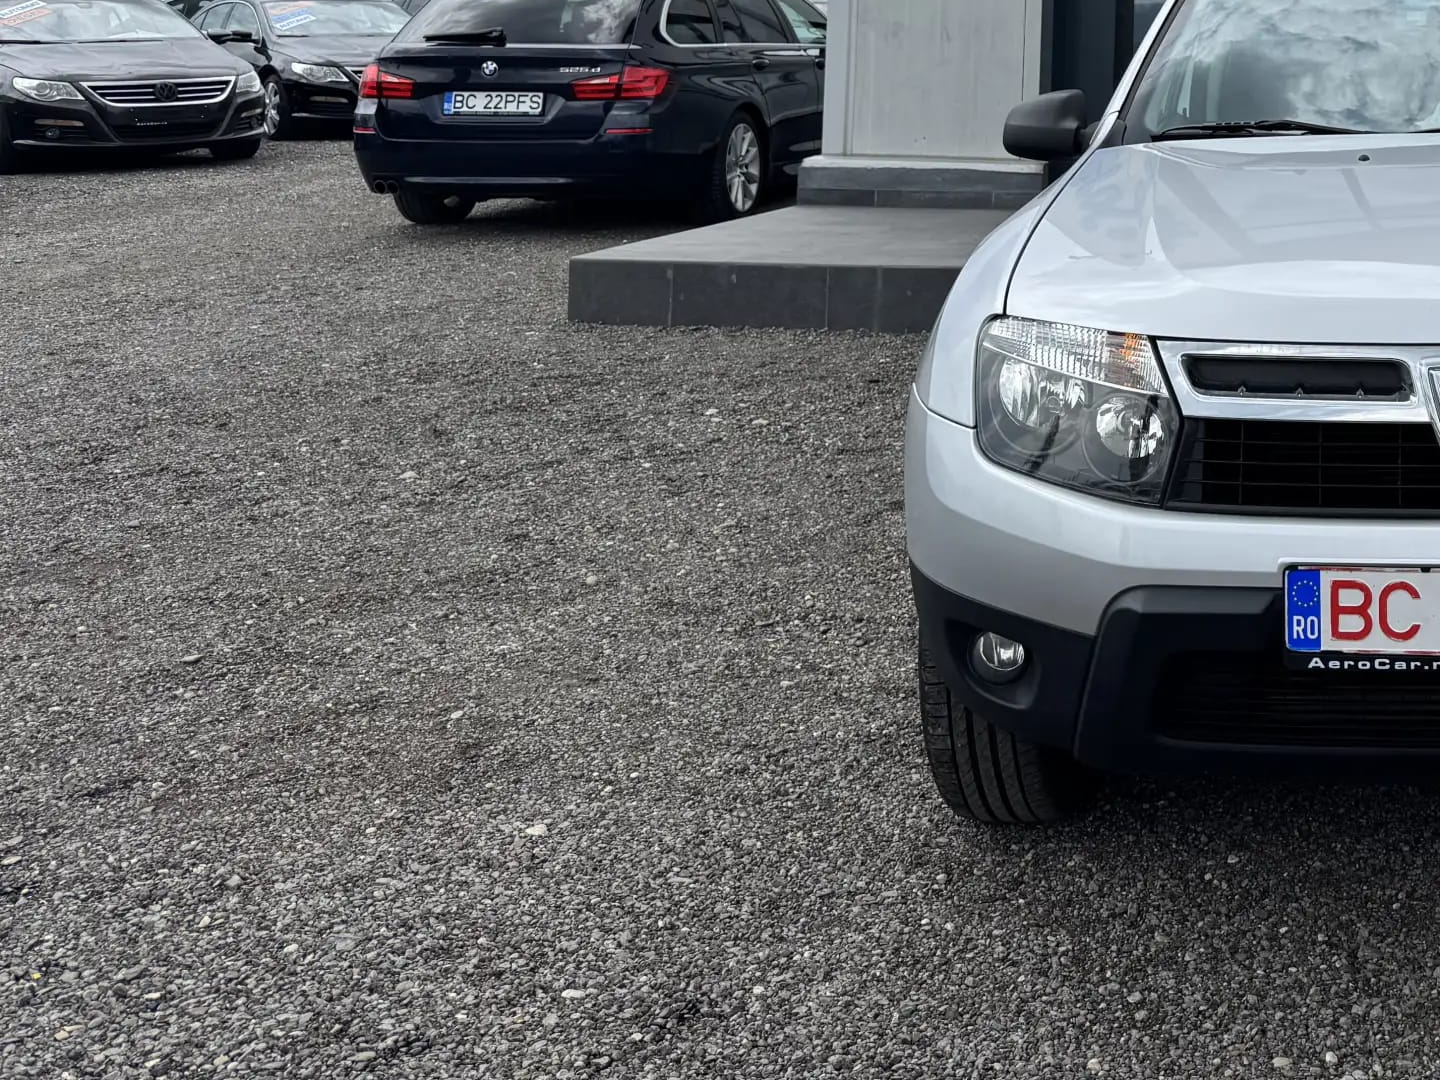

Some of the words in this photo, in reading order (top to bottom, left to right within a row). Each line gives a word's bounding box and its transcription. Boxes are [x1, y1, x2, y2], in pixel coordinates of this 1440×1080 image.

[453, 94, 477, 110] BC
[483, 94, 541, 110] 22PFS
[1330, 579, 1422, 642] BC
[1293, 615, 1319, 639] RO
